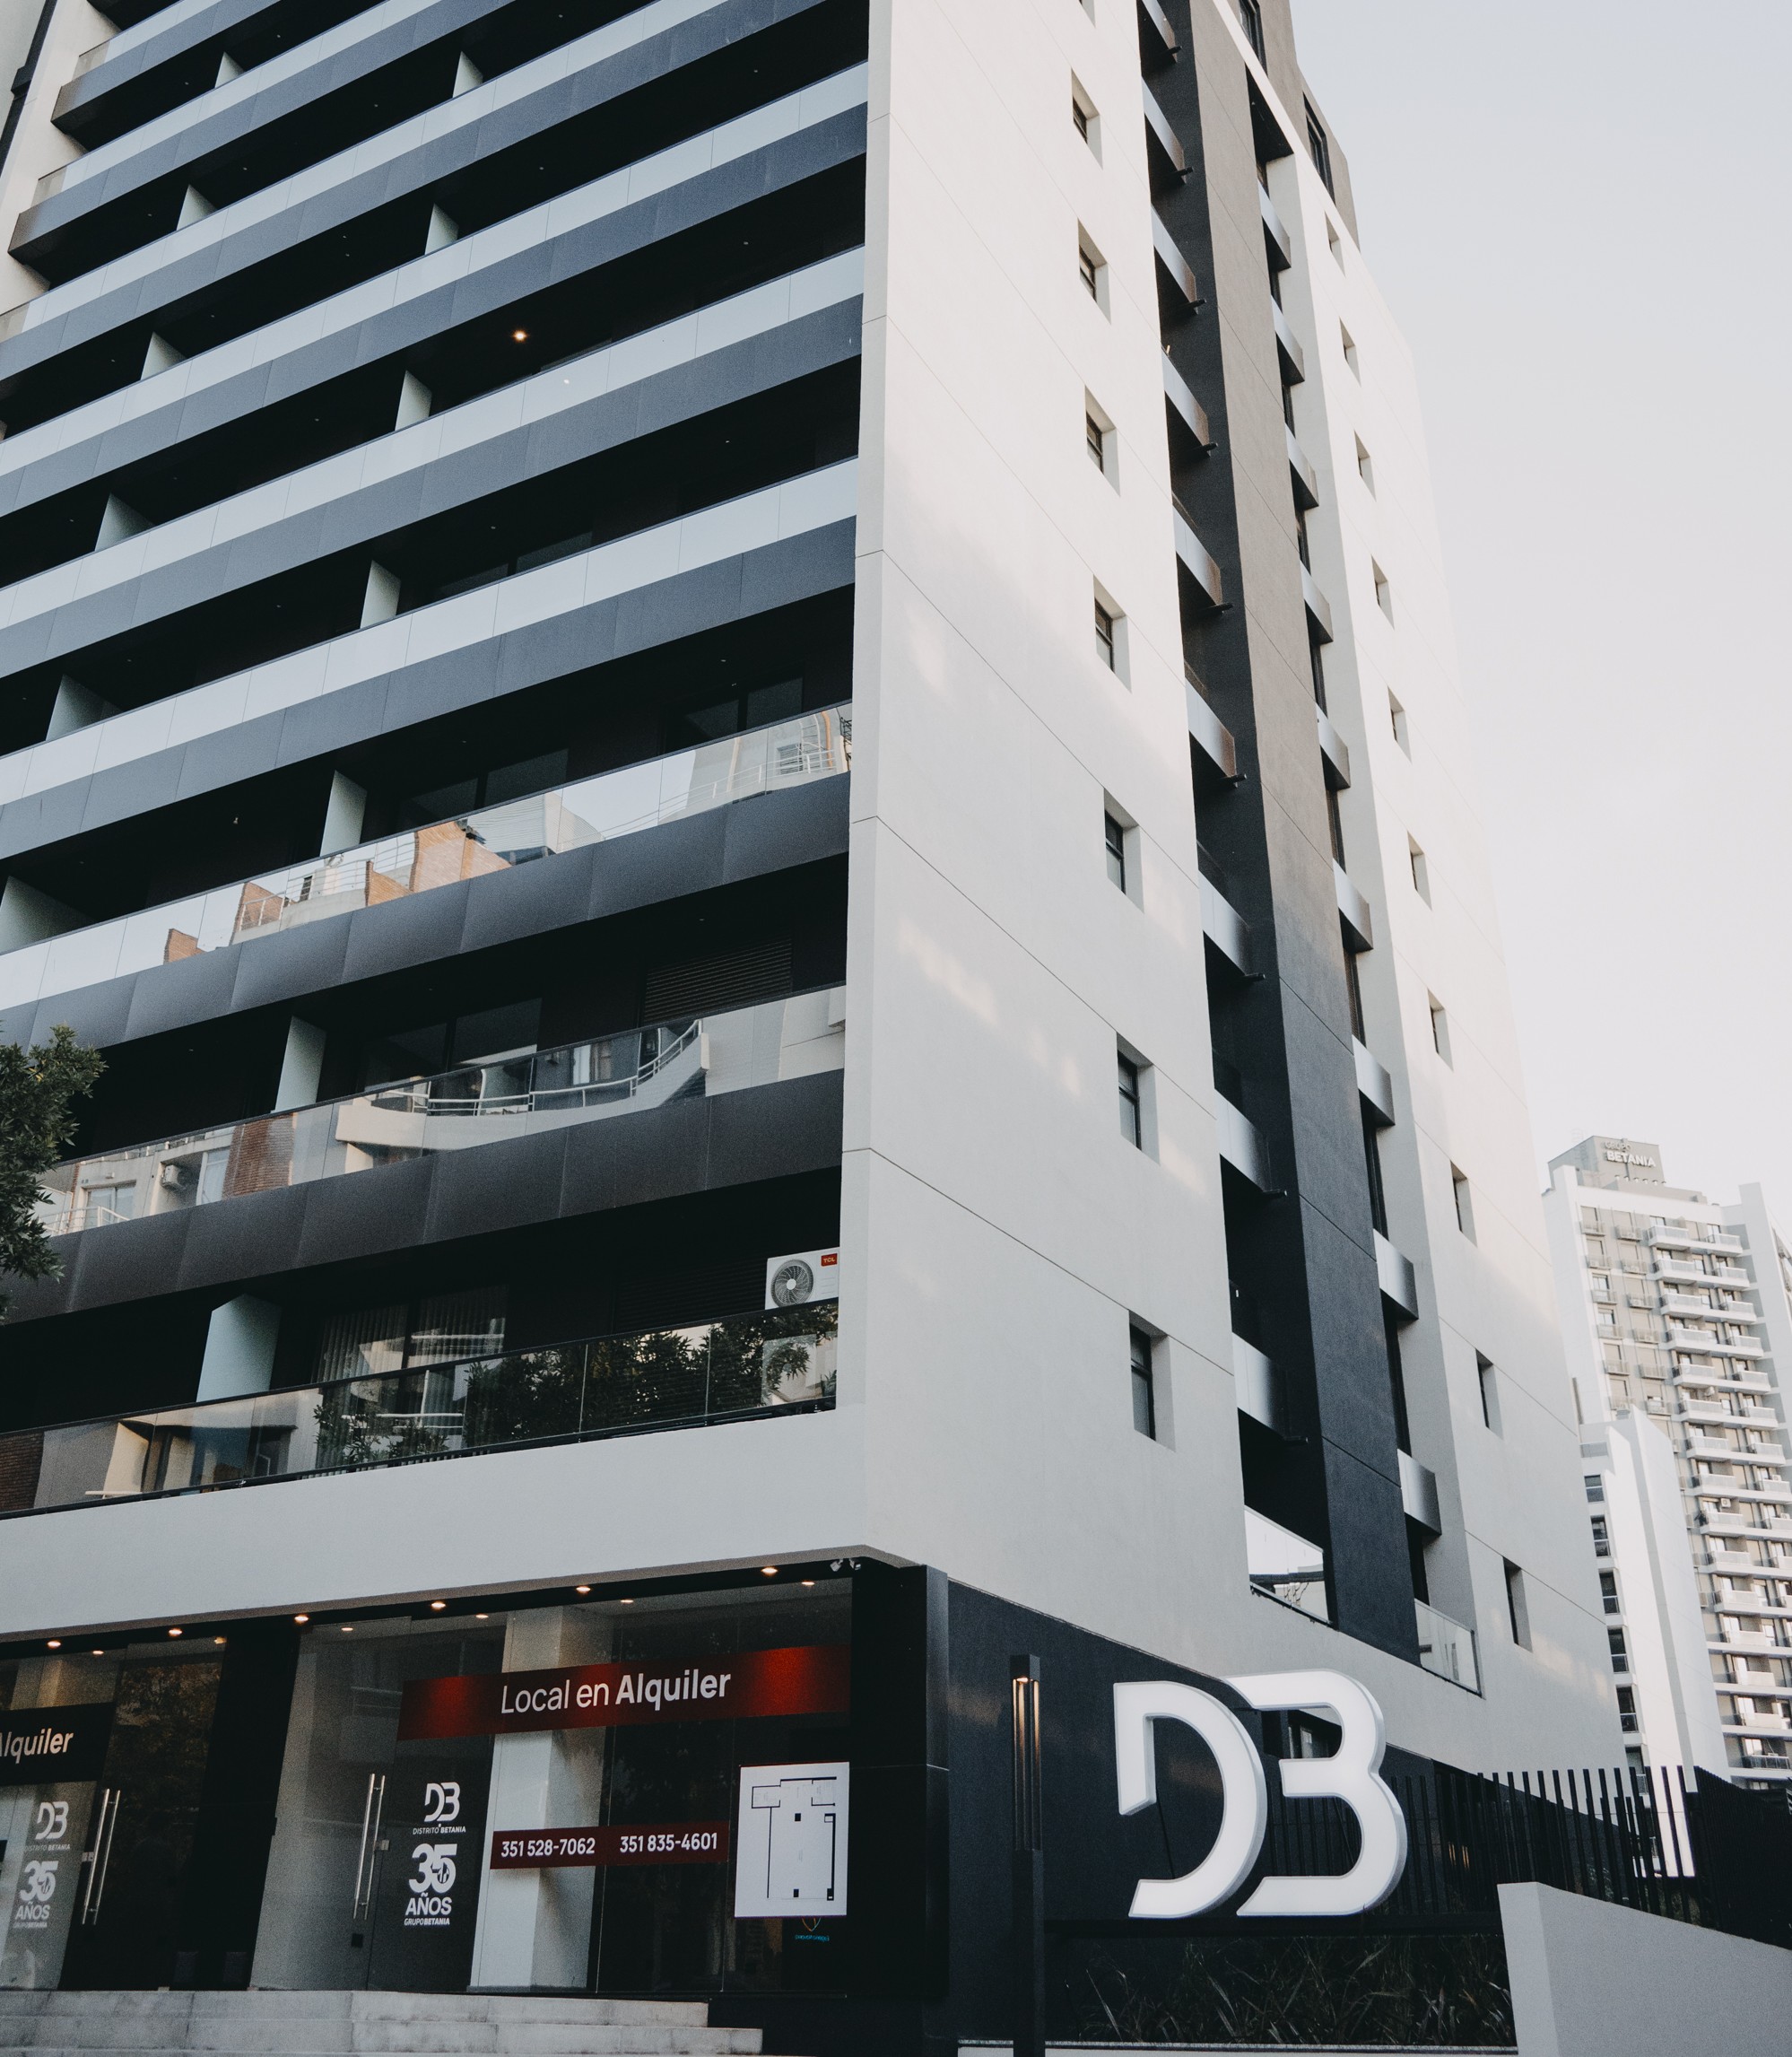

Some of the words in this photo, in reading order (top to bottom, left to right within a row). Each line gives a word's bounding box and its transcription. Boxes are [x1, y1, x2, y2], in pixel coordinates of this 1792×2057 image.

[1605, 1140, 1631, 1151] GRUPO
[1606, 1150, 1656, 1167] BETANIA
[501, 1679, 570, 1714] Local
[577, 1683, 610, 1708] en
[615, 1669, 731, 1711] Alquiler
[0, 1728, 74, 1765] lquiler
[424, 1782, 460, 1822] DB
[1113, 1669, 1408, 1919] DB
[35, 1801, 69, 1840] DB
[413, 1827, 439, 1835] DISTRITO
[440, 1826, 466, 1834] BETANIA
[501, 1841, 524, 1857] 351
[526, 1837, 596, 1857] 528-7062
[620, 1835, 643, 1853] 351
[647, 1832, 718, 1852] 835-4601
[20, 1860, 59, 1902] 35
[409, 1843, 457, 1894] 35
[15, 1902, 50, 1920] AÑOS
[405, 1892, 452, 1916] AÑOS
